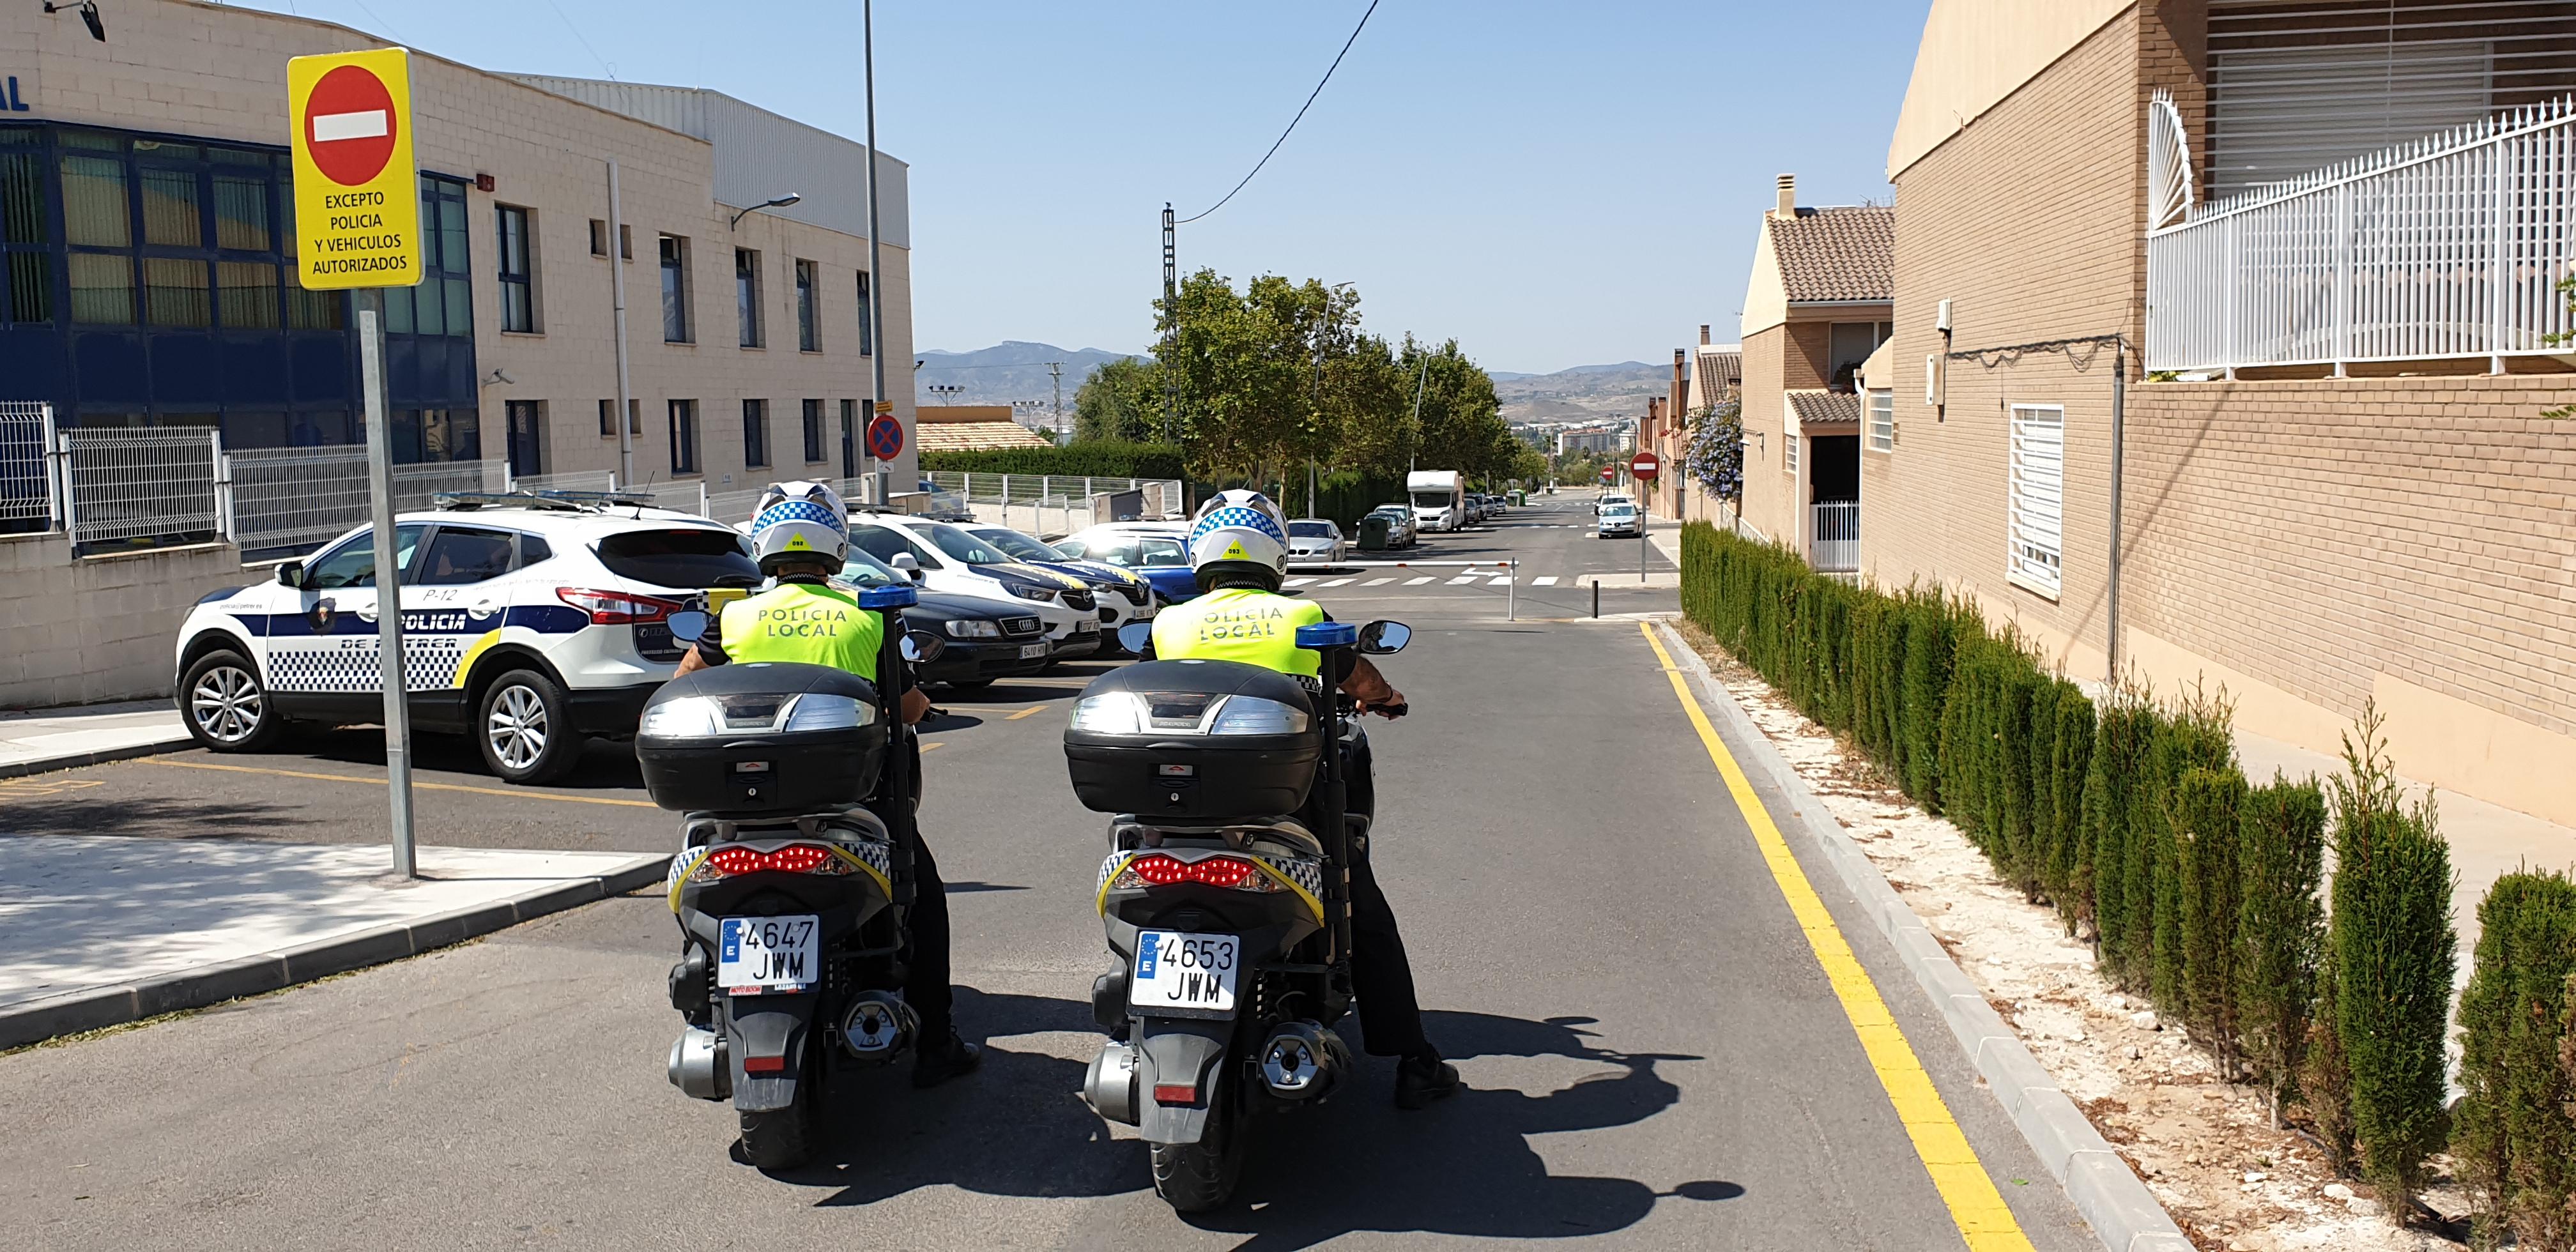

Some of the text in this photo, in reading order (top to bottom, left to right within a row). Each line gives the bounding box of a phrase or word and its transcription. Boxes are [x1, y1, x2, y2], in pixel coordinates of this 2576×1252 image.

[326, 192, 384, 209] EXCEPTO
[331, 214, 383, 230] POLICIA
[314, 234, 401, 253] Y VEHICULOS
[312, 256, 407, 275] AUTORIZADOS
[423, 589, 457, 601] P-12
[758, 609, 847, 622] POLICIA
[768, 624, 837, 637] LOCAL
[1200, 622, 1275, 641] LOCAL
[341, 639, 367, 649] DE
[746, 921, 814, 949] 4647
[726, 945, 735, 956] E
[1163, 939, 1234, 970] 4653
[753, 952, 804, 980] JWM
[1142, 960, 1152, 972] E
[1167, 972, 1222, 1003] JWM
